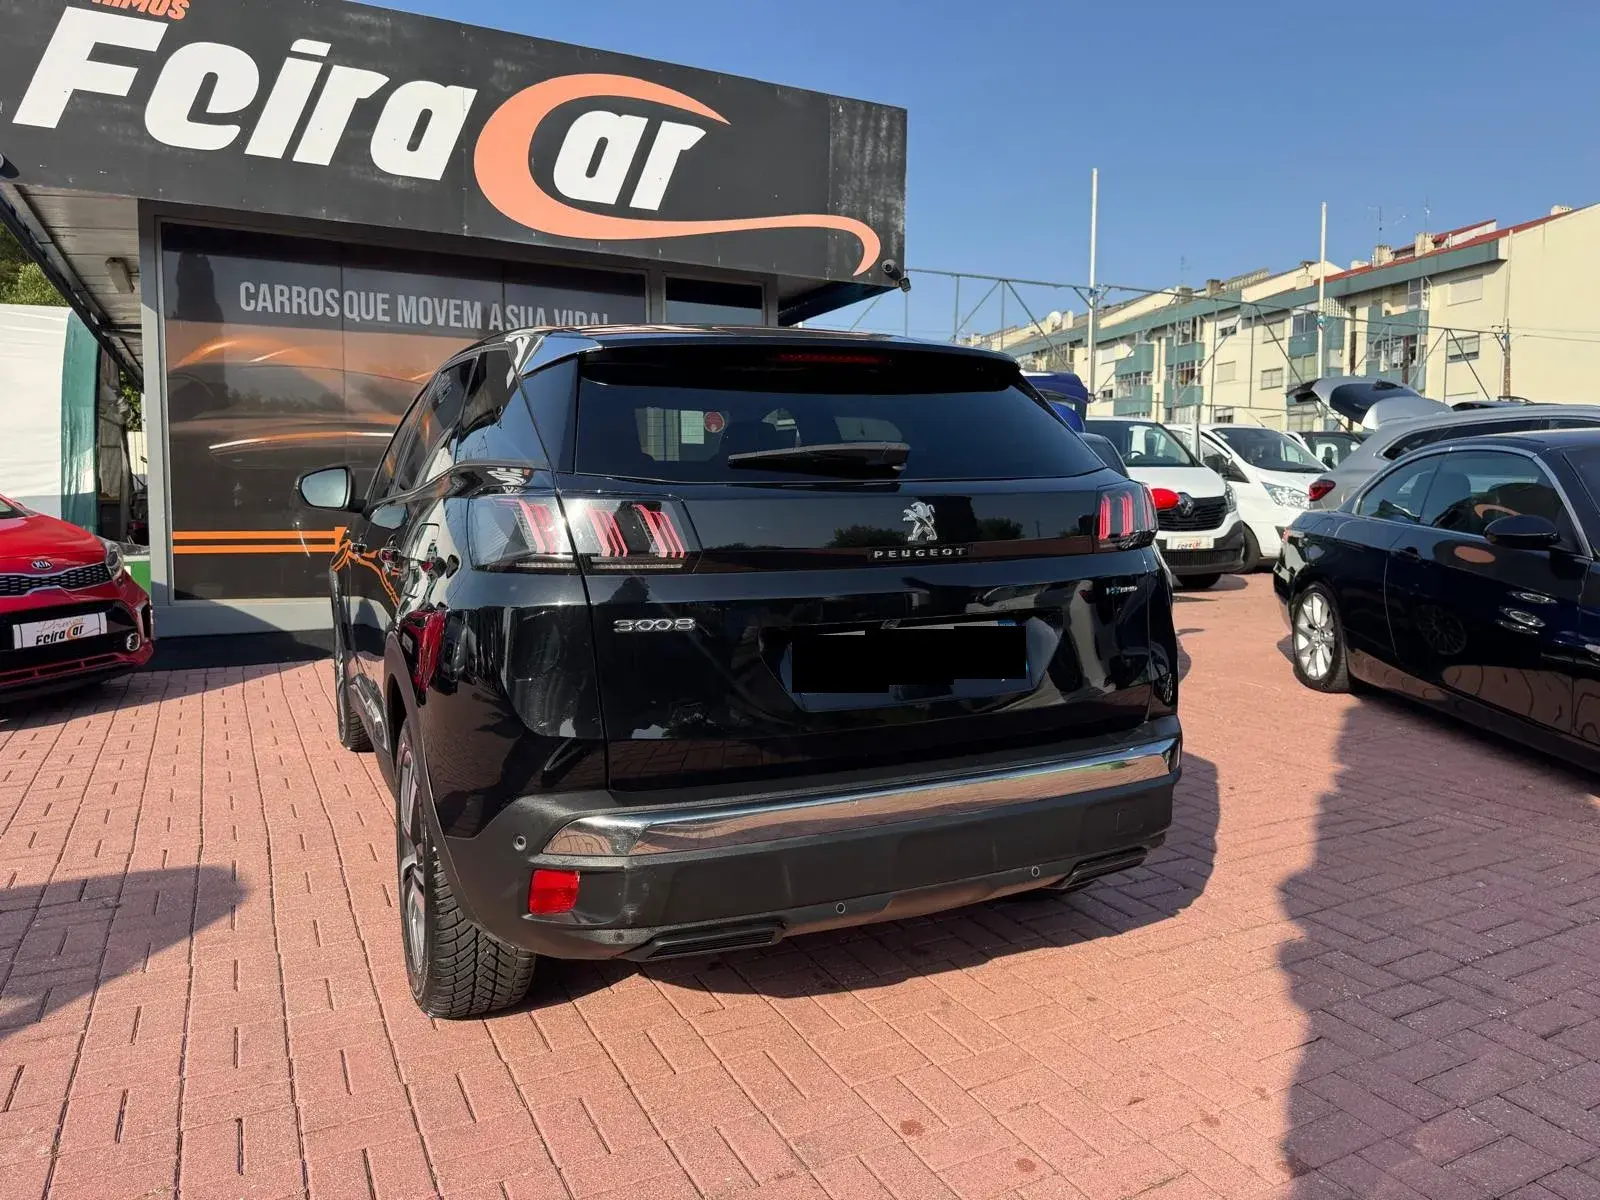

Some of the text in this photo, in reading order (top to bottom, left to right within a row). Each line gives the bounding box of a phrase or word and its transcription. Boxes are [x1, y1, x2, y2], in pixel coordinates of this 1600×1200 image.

[239, 281, 340, 318] CARROS
[343, 289, 391, 323] QUE
[397, 294, 483, 330] MOVEM
[873, 547, 967, 559] PEUGEOT
[613, 618, 696, 632] 3008
